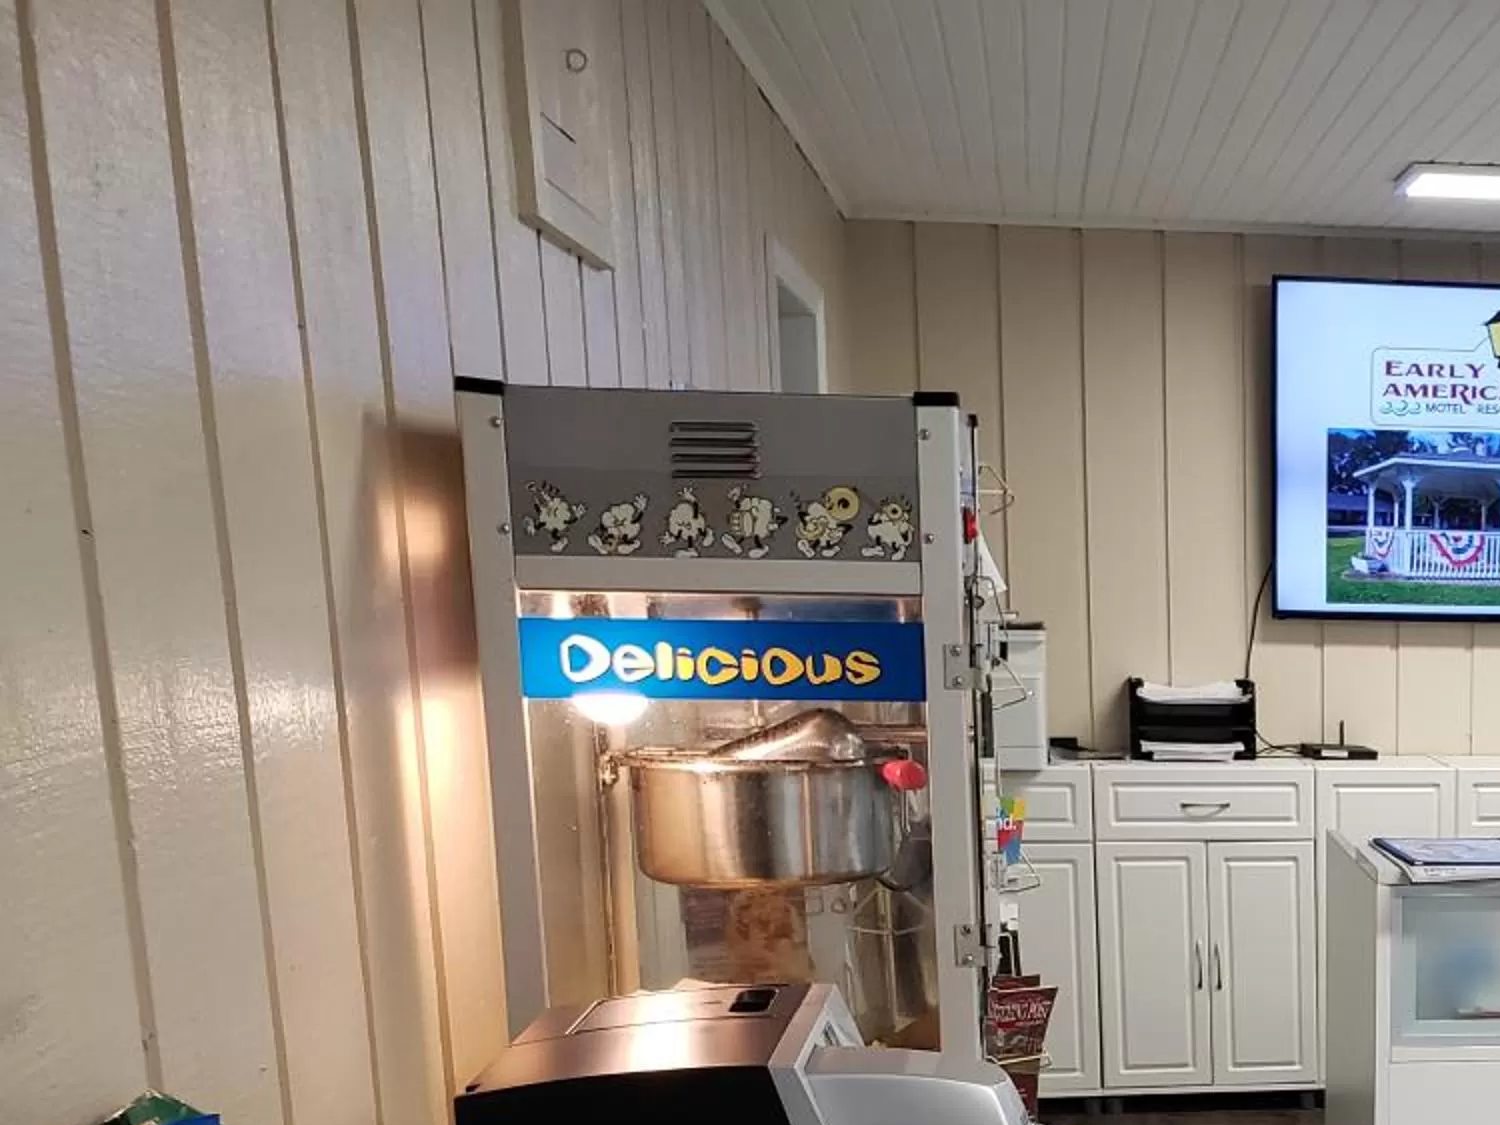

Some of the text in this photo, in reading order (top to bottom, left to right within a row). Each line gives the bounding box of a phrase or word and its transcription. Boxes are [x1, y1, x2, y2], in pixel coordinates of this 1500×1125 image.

[1385, 360, 1486, 379] EARLY
[1425, 403, 1466, 415] MOTEL
[560, 633, 882, 686] Delicious
